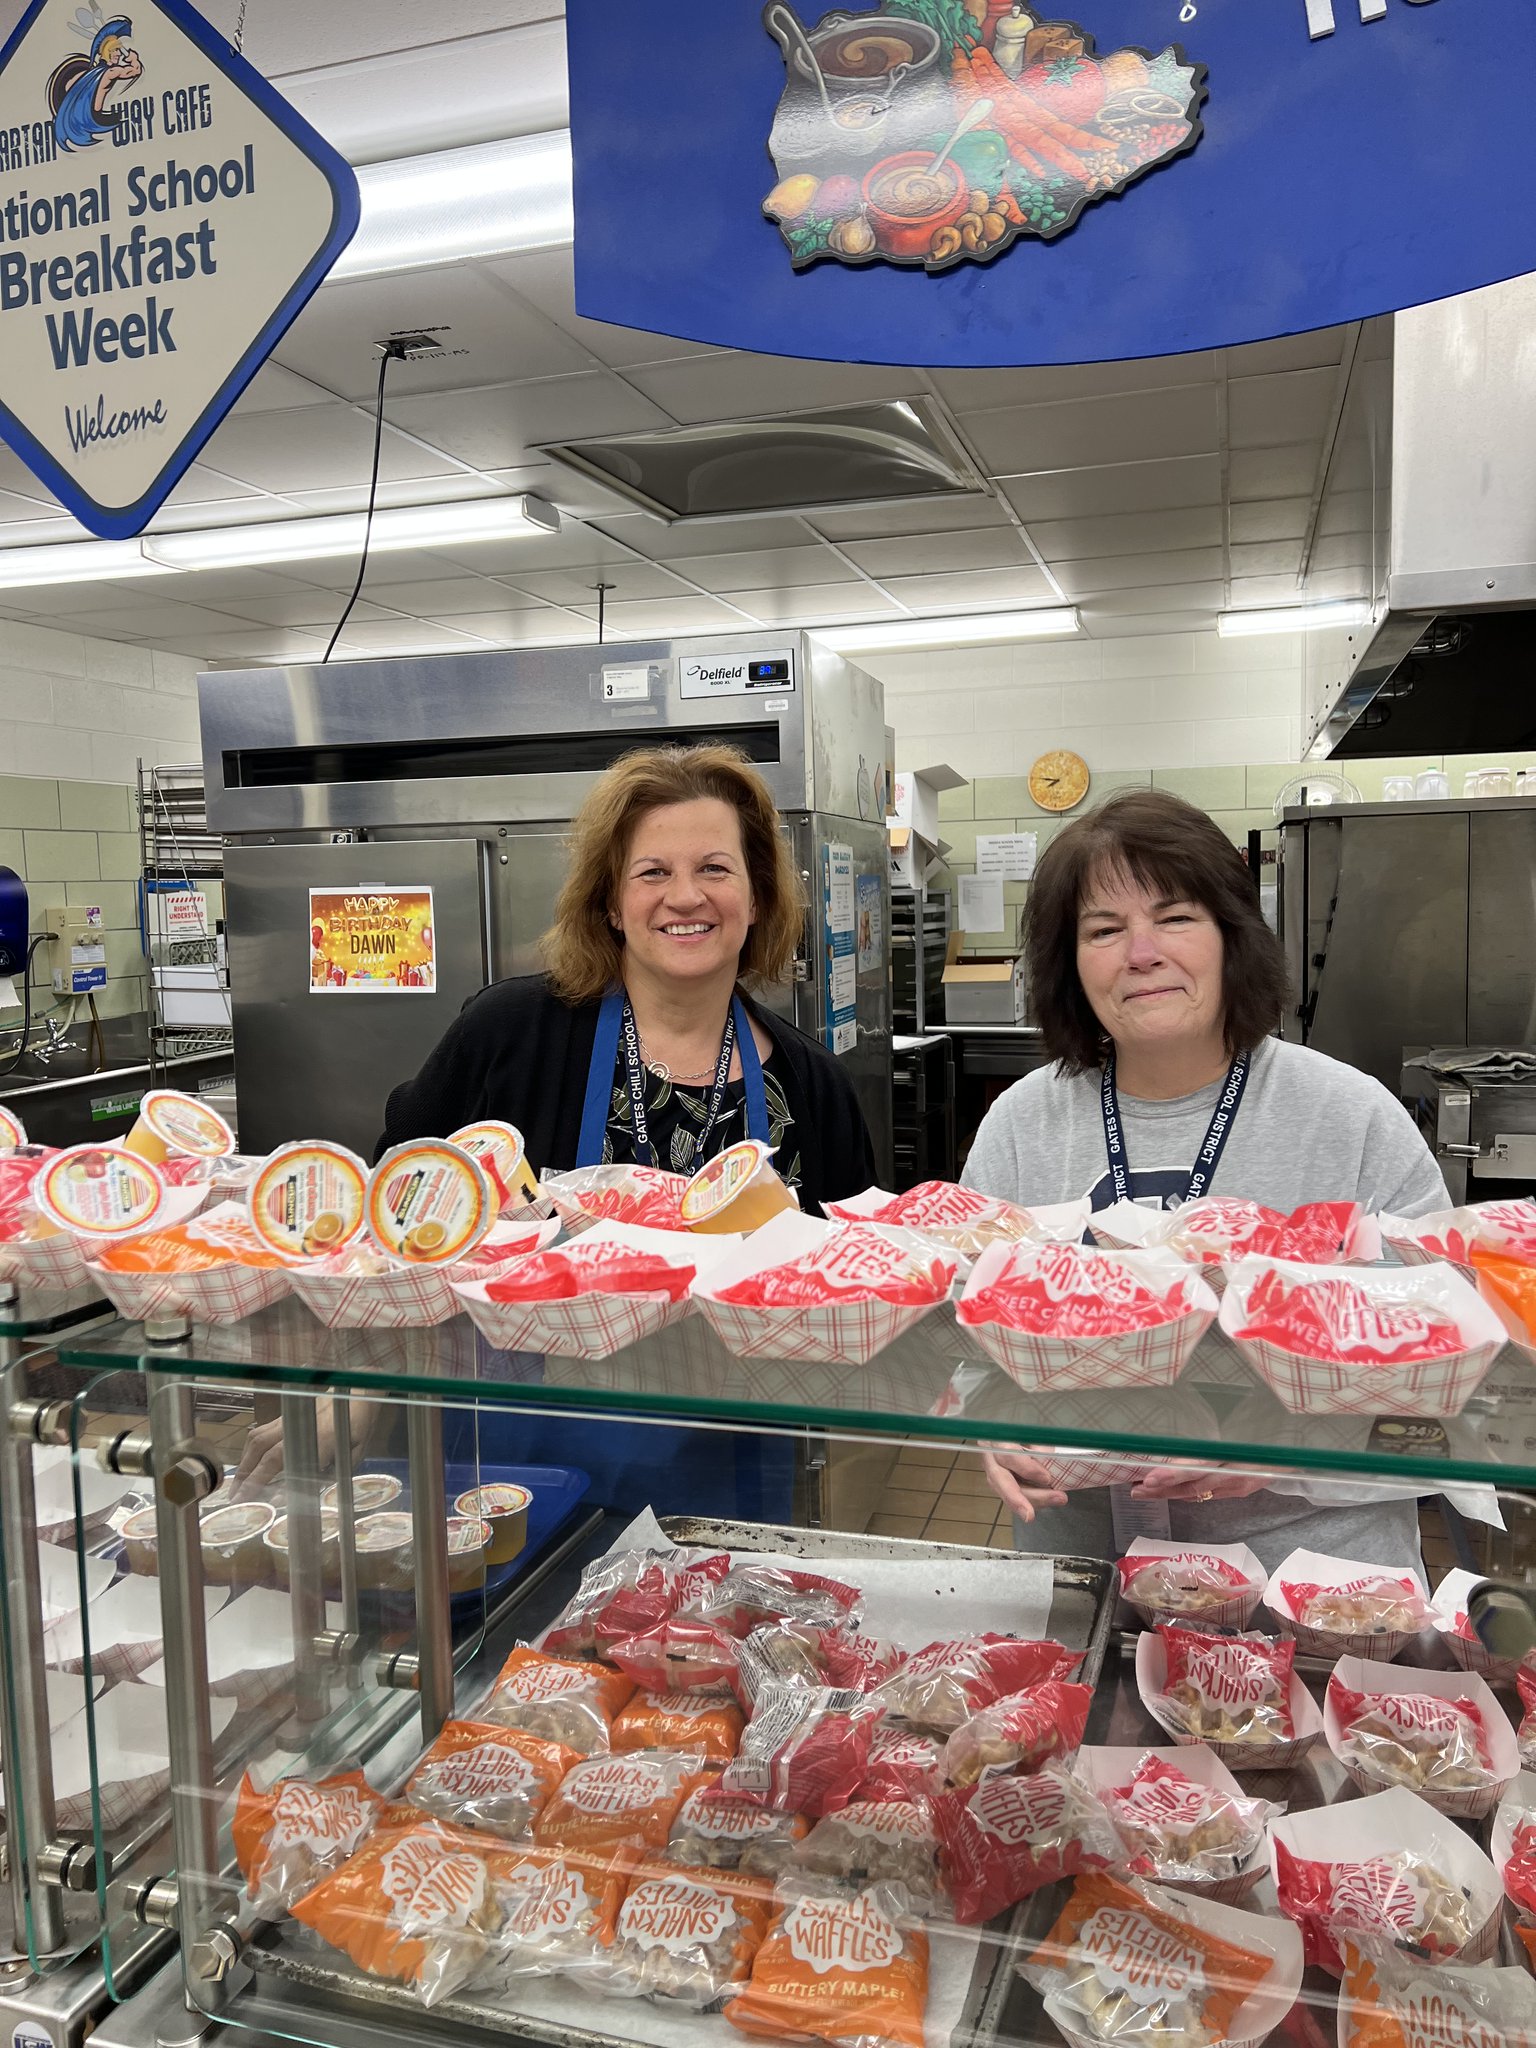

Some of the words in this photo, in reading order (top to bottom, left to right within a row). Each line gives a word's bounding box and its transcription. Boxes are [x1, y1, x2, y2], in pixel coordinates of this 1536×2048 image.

[111, 96, 155, 148] WAY
[162, 84, 212, 135] CAFE
[0, 174, 110, 242] tional
[127, 145, 255, 217] School
[0, 218, 217, 311] Breakfast
[45, 296, 178, 370] Week
[64, 394, 168, 453] Welcome
[606, 684, 614, 696] 3
[700, 666, 742, 681] Delfield
[343, 896, 400, 913] HAPPY
[329, 915, 412, 933] BIRTHDAY
[351, 934, 396, 955] DAWN
[625, 1017, 640, 1066] SCHOOL
[724, 1018, 735, 1046] CHILI
[630, 1069, 644, 1100] CHILI
[714, 1046, 731, 1090] SCHOOL
[1103, 1087, 1115, 1116] CHILI
[1219, 1066, 1244, 1111] SCHOOL
[633, 1102, 648, 1144] GATES
[706, 1093, 721, 1130] DISTR
[1106, 1117, 1121, 1154] GATES
[1200, 1112, 1229, 1165] DISTRICT
[397, 1175, 421, 1221] SUNCUP
[1113, 1164, 1128, 1204] STRICT
[1185, 1172, 1206, 1203] GATE
[287, 1182, 296, 1226] SUNCUP
[1275, 1316, 1331, 1347] SWEE
[449, 1748, 527, 1780] WAFFLES
[570, 1784, 652, 1810] WAFFLES
[1016, 1774, 1066, 1831] NACKN
[634, 1884, 726, 1914] WAFFLES
[795, 1919, 889, 1963] WAFFLES
[1098, 1912, 1198, 1974] WAFFLES
[767, 1980, 840, 1997] BUTTERY
[842, 1981, 905, 2001] MAPLE!
